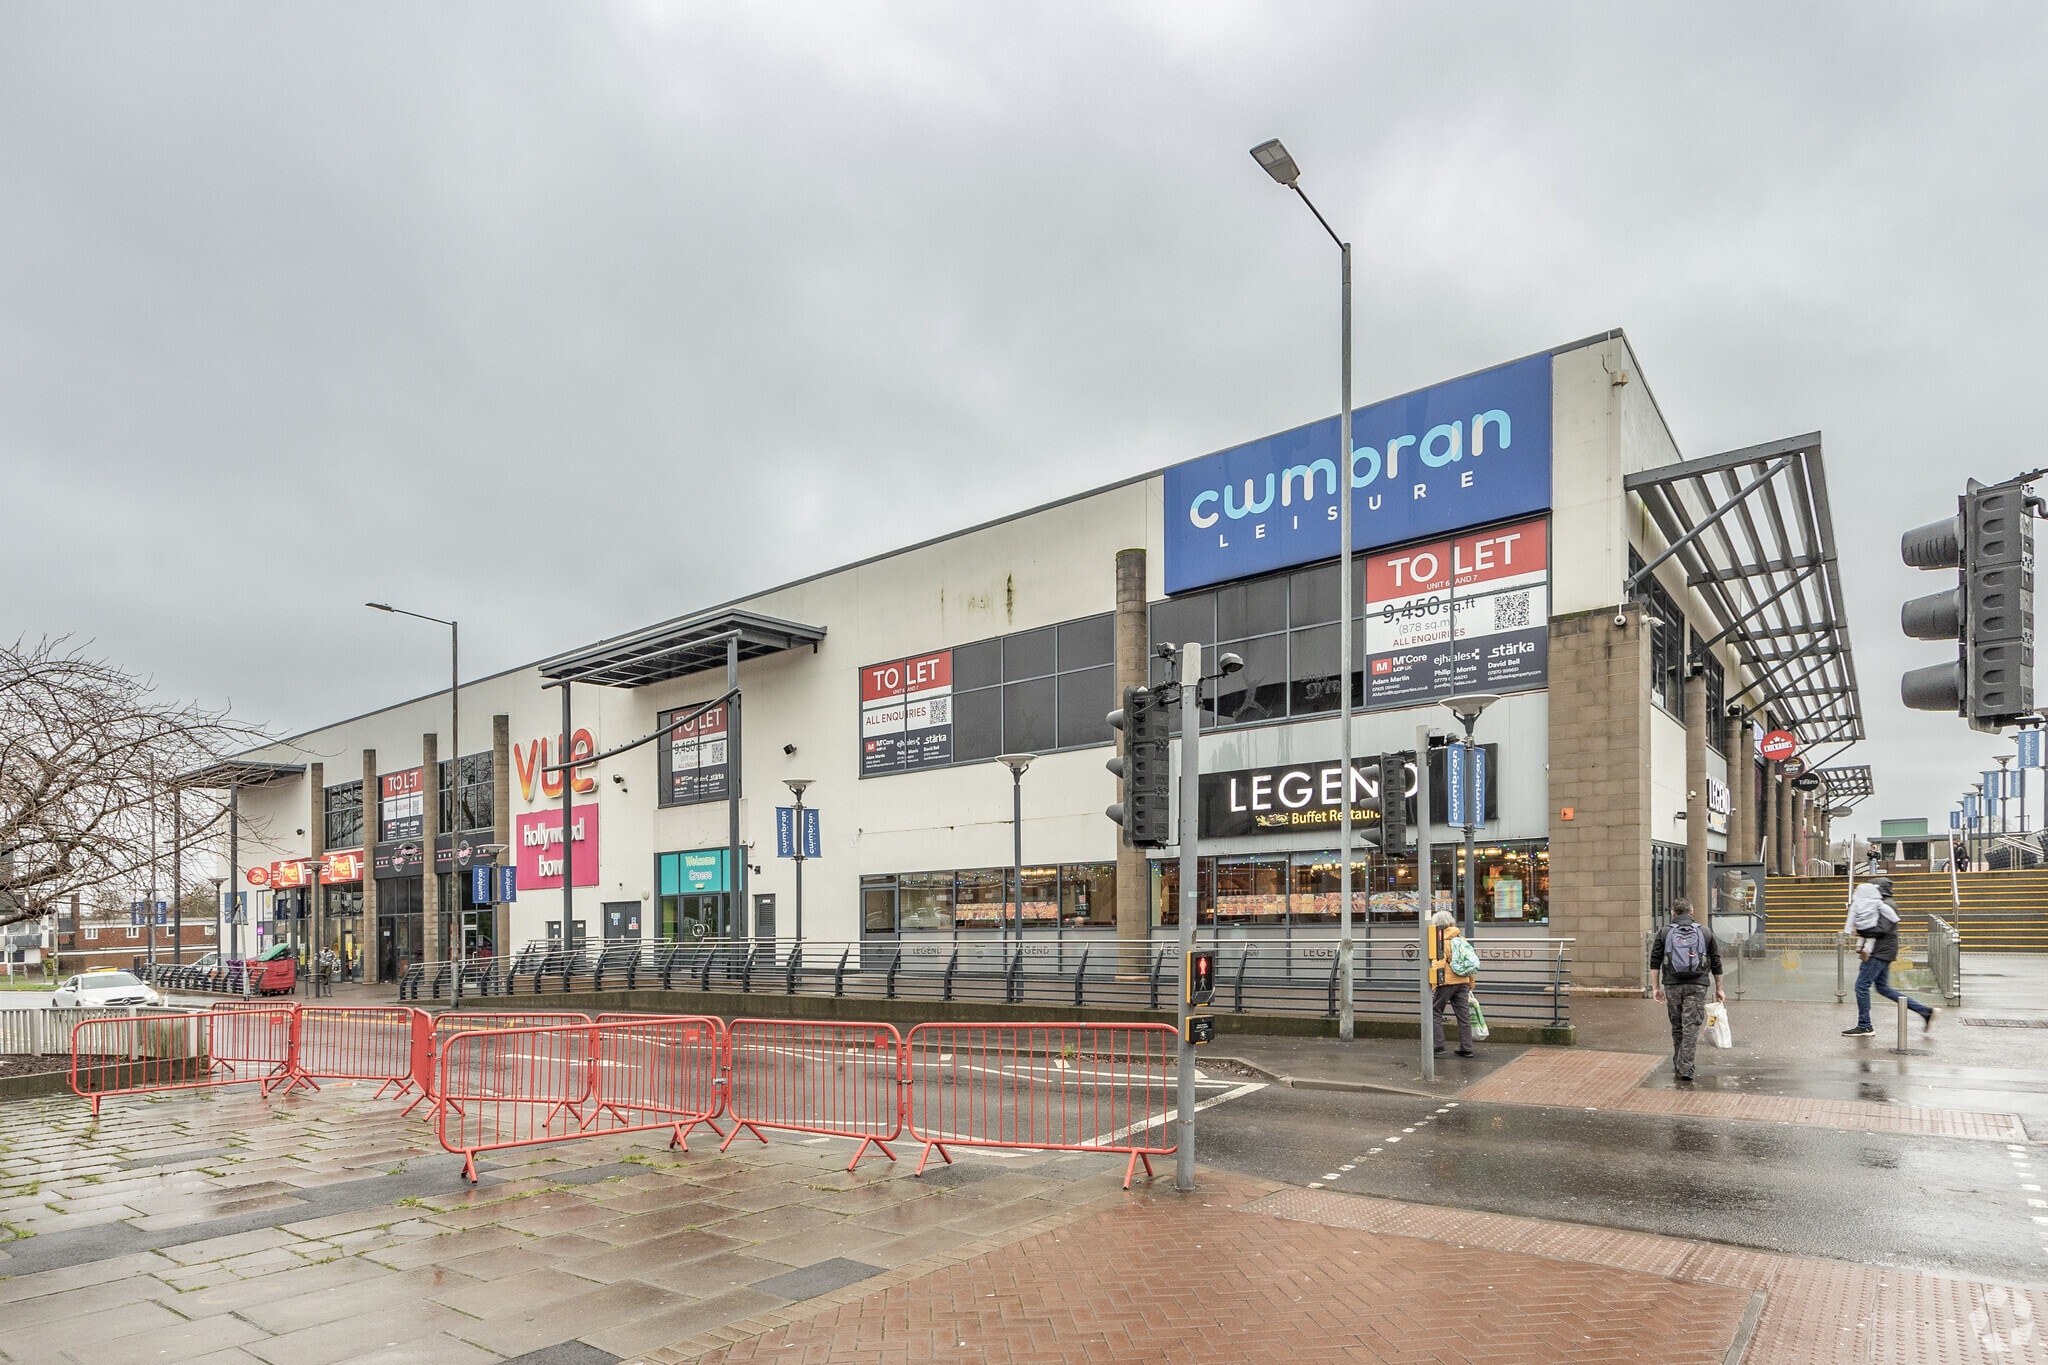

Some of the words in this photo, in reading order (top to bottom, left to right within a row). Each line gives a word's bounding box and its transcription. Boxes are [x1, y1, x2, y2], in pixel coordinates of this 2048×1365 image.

[1190, 409, 1511, 528] cwmbran
[1219, 471, 1473, 548] LEISURE
[1388, 553, 1438, 587] TO
[1454, 533, 1521, 575] LET
[1426, 580, 1444, 590] UNIT
[1455, 576, 1472, 585] AND
[1383, 596, 1440, 625] 9,450
[1442, 596, 1476, 614] sq.ft
[1393, 638, 1409, 647] ALL
[1411, 628, 1466, 644] ENQUIRIES
[1399, 622, 1422, 636] (878
[1487, 641, 1535, 659] stärka
[1376, 662, 1388, 672] M
[1456, 665, 1477, 673] Morris
[1488, 660, 1506, 669] David
[1507, 658, 1520, 666] Bell
[873, 668, 899, 691] TO
[907, 658, 939, 685] LET
[1390, 675, 1410, 683] Martin
[676, 714, 695, 734] TO
[699, 708, 722, 729] LET
[866, 715, 880, 726] ALL
[881, 707, 926, 722] ENQUIRIES
[2024, 733, 2032, 766] cwmbran
[388, 775, 403, 792] TO
[404, 771, 419, 789] LET
[1292, 810, 1328, 825] Buffet
[1330, 809, 1381, 821] Retaur
[524, 817, 585, 851] hollywd
[539, 854, 564, 877] bow
[685, 856, 716, 867] Welcome
[912, 945, 943, 955] LEGEND
[1021, 945, 1050, 955] GEND
[1303, 948, 1338, 957] LEGE
[1479, 948, 1533, 959] EGEND
